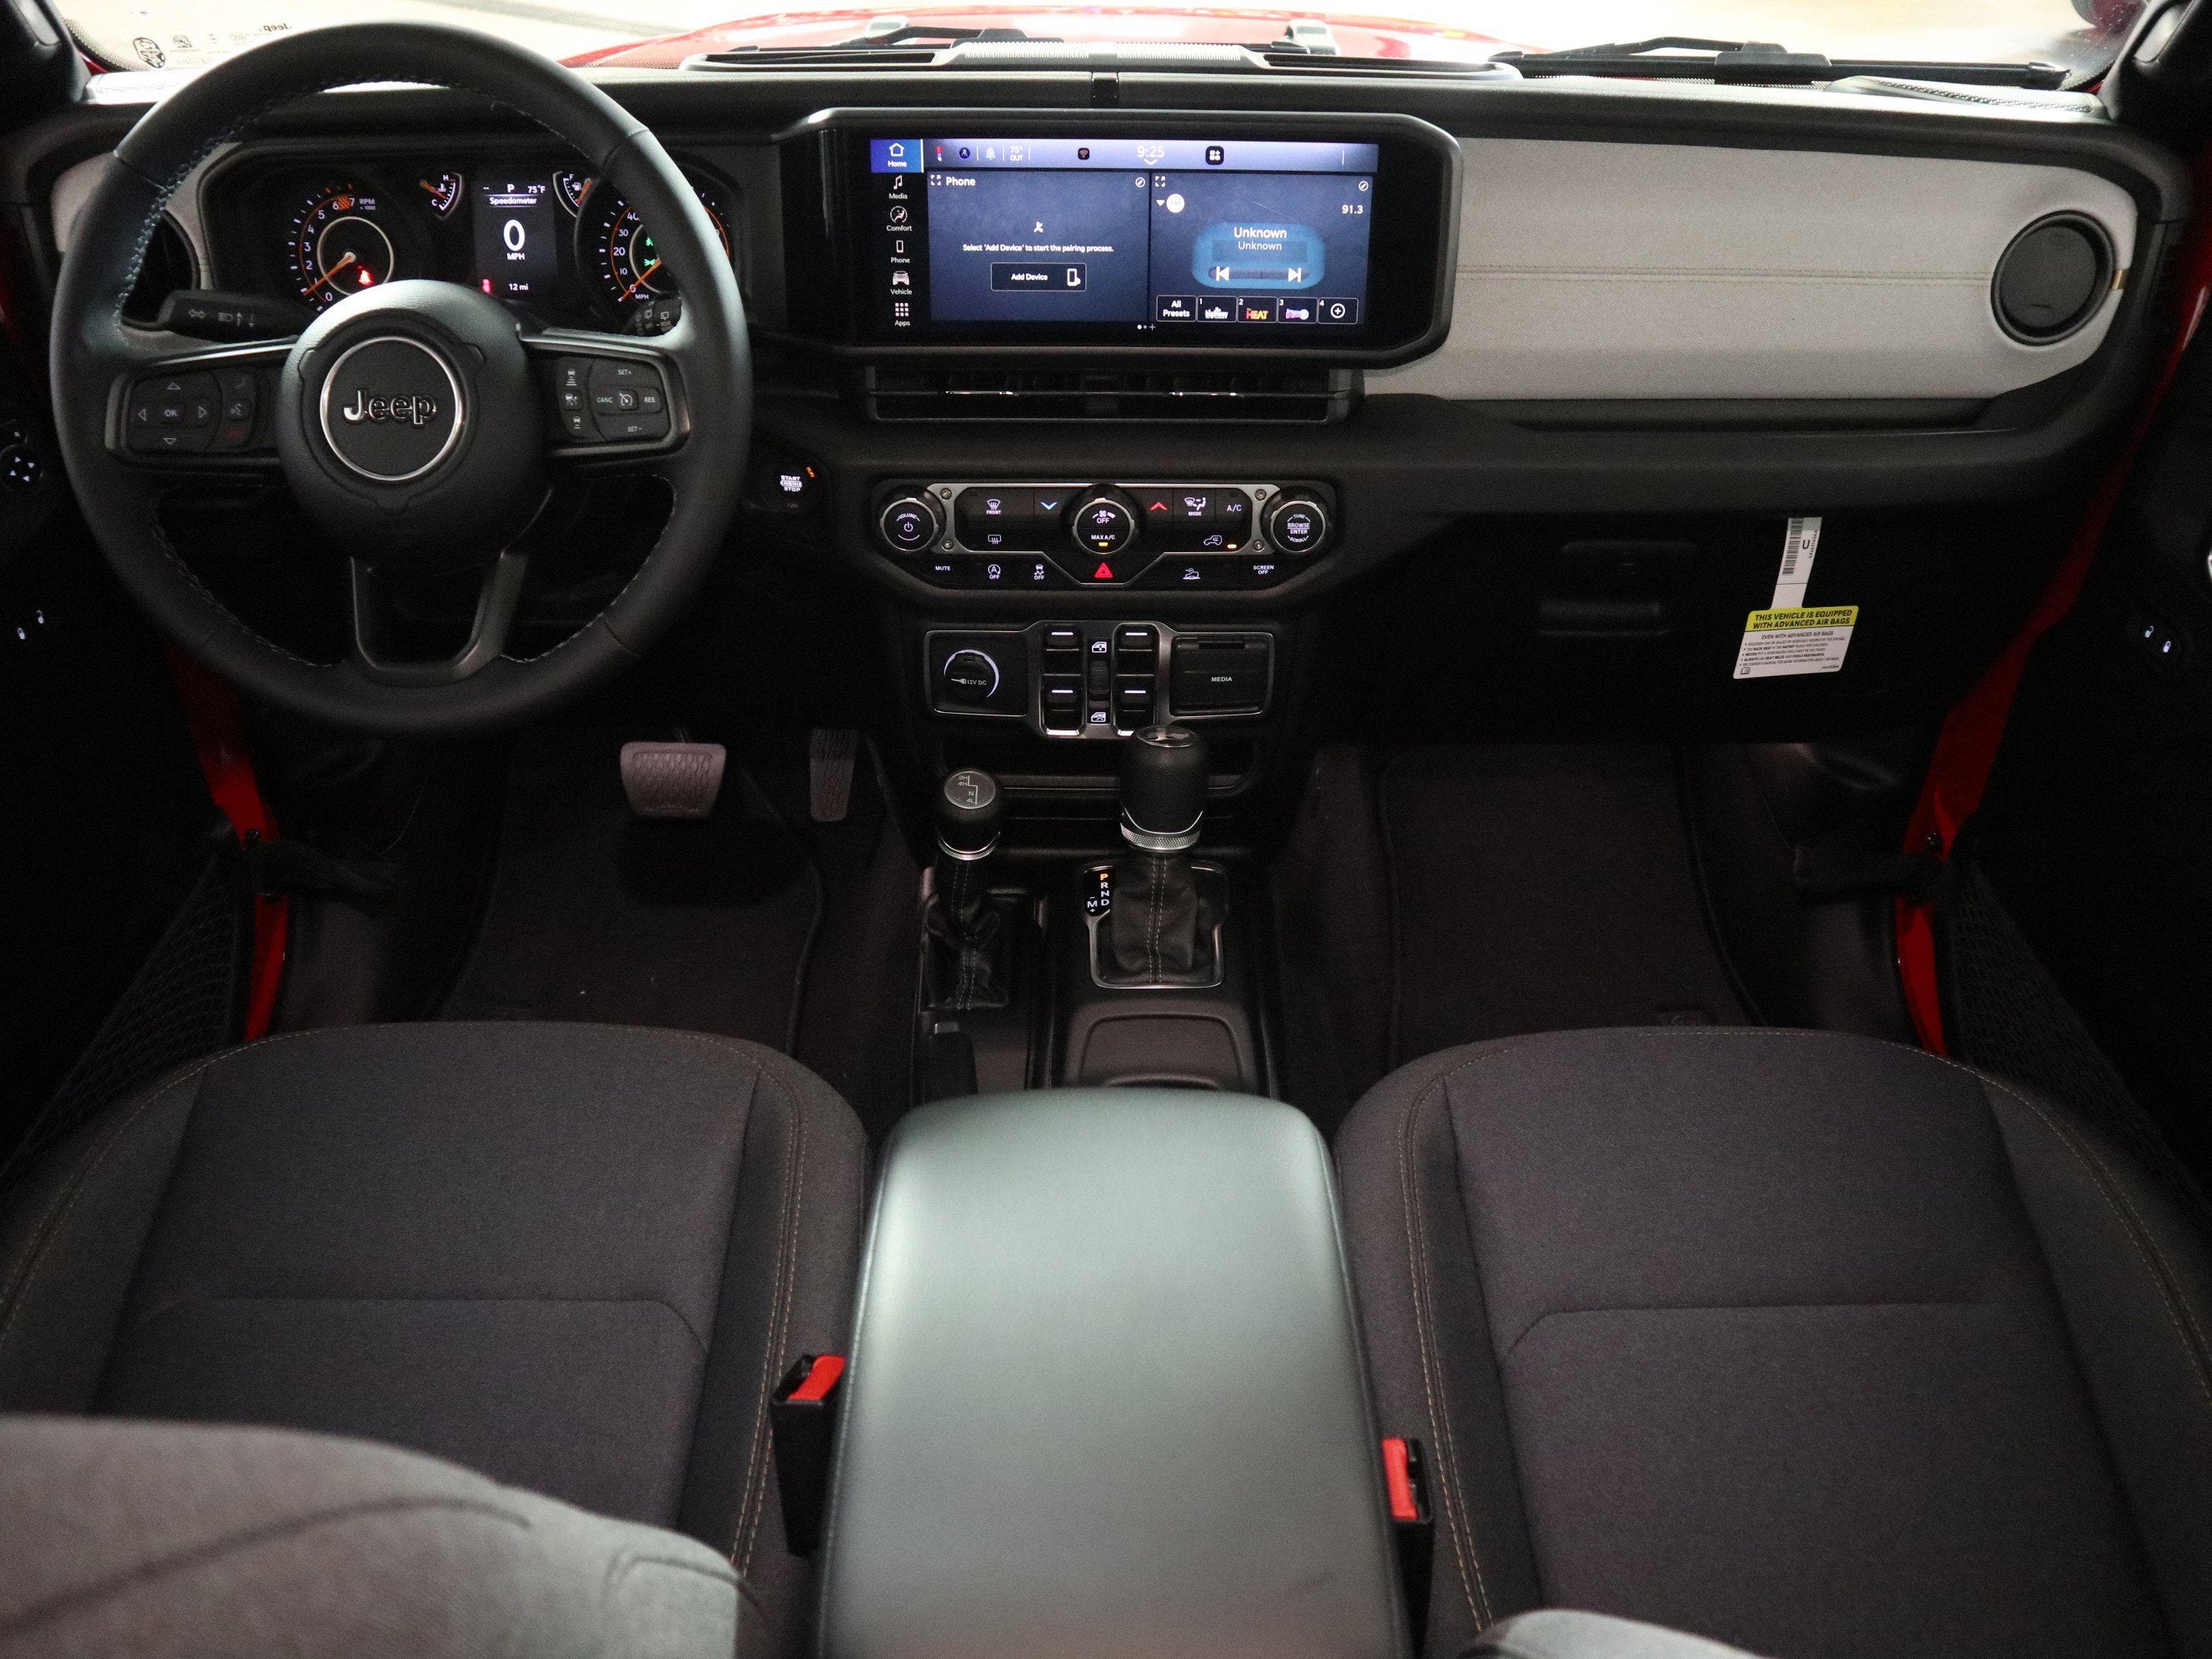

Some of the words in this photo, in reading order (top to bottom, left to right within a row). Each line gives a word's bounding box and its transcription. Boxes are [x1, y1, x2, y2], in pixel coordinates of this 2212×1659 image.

[1137, 146, 1165, 157] 9:25
[946, 177, 976, 186] Phone
[507, 184, 515, 193] P
[332, 201, 339, 210] 6
[349, 198, 355, 207] 7
[490, 197, 537, 206] Speedometer
[318, 210, 325, 219] 5
[1342, 205, 1363, 215] 91.3
[307, 225, 315, 234] 4
[1233, 227, 1287, 240] Unknown
[503, 219, 526, 251] 0
[304, 242, 311, 252] 3
[1238, 241, 1282, 250] Unknown
[613, 247, 625, 256] 20
[306, 261, 313, 270] 2
[325, 292, 332, 301] 0
[1163, 309, 1190, 317] Presets
[1246, 310, 1268, 320] HEAT
[343, 388, 437, 427] Jeep
[1226, 504, 1242, 512] A/C
[1802, 540, 1811, 550] U
